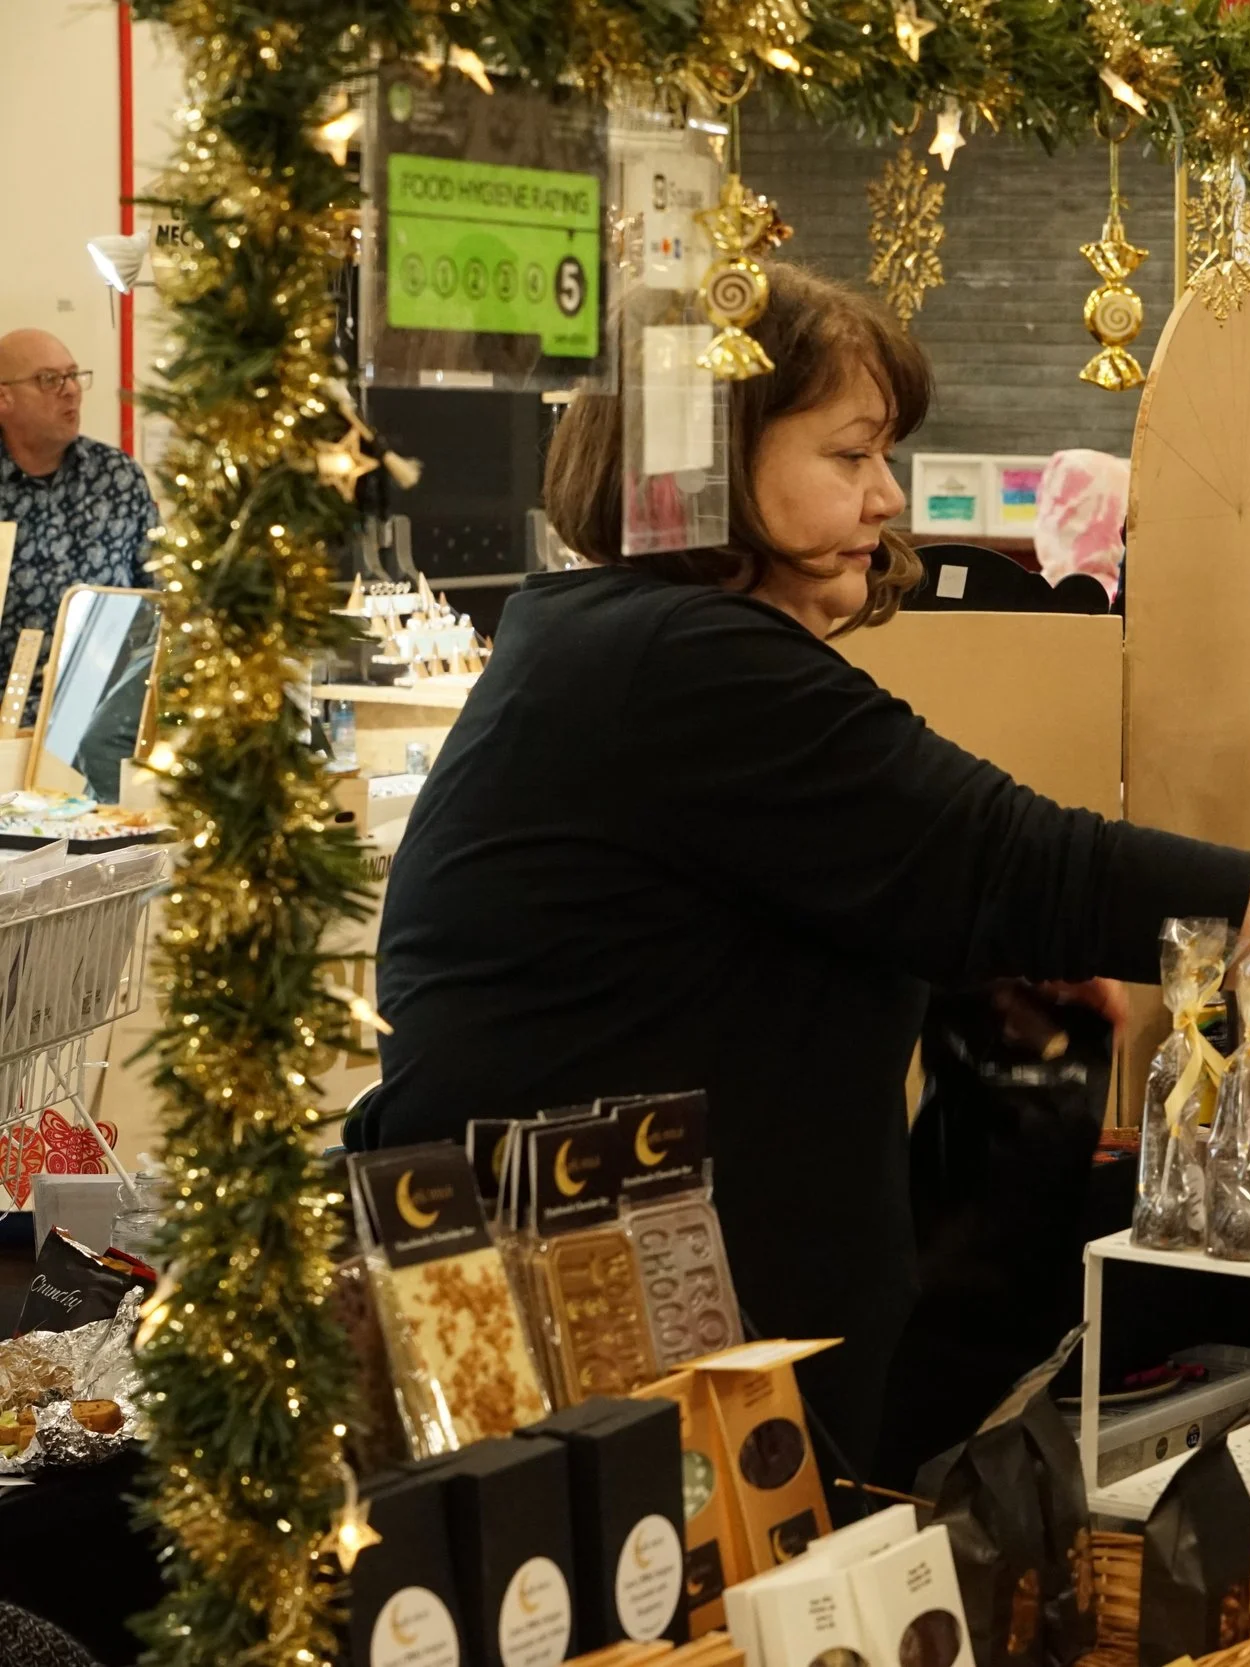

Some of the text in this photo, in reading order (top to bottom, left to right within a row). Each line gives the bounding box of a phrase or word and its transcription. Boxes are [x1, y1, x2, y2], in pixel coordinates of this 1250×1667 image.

[402, 172, 454, 202] FOOD
[561, 262, 581, 312] 5
[30, 1274, 83, 1313] Crunchy
